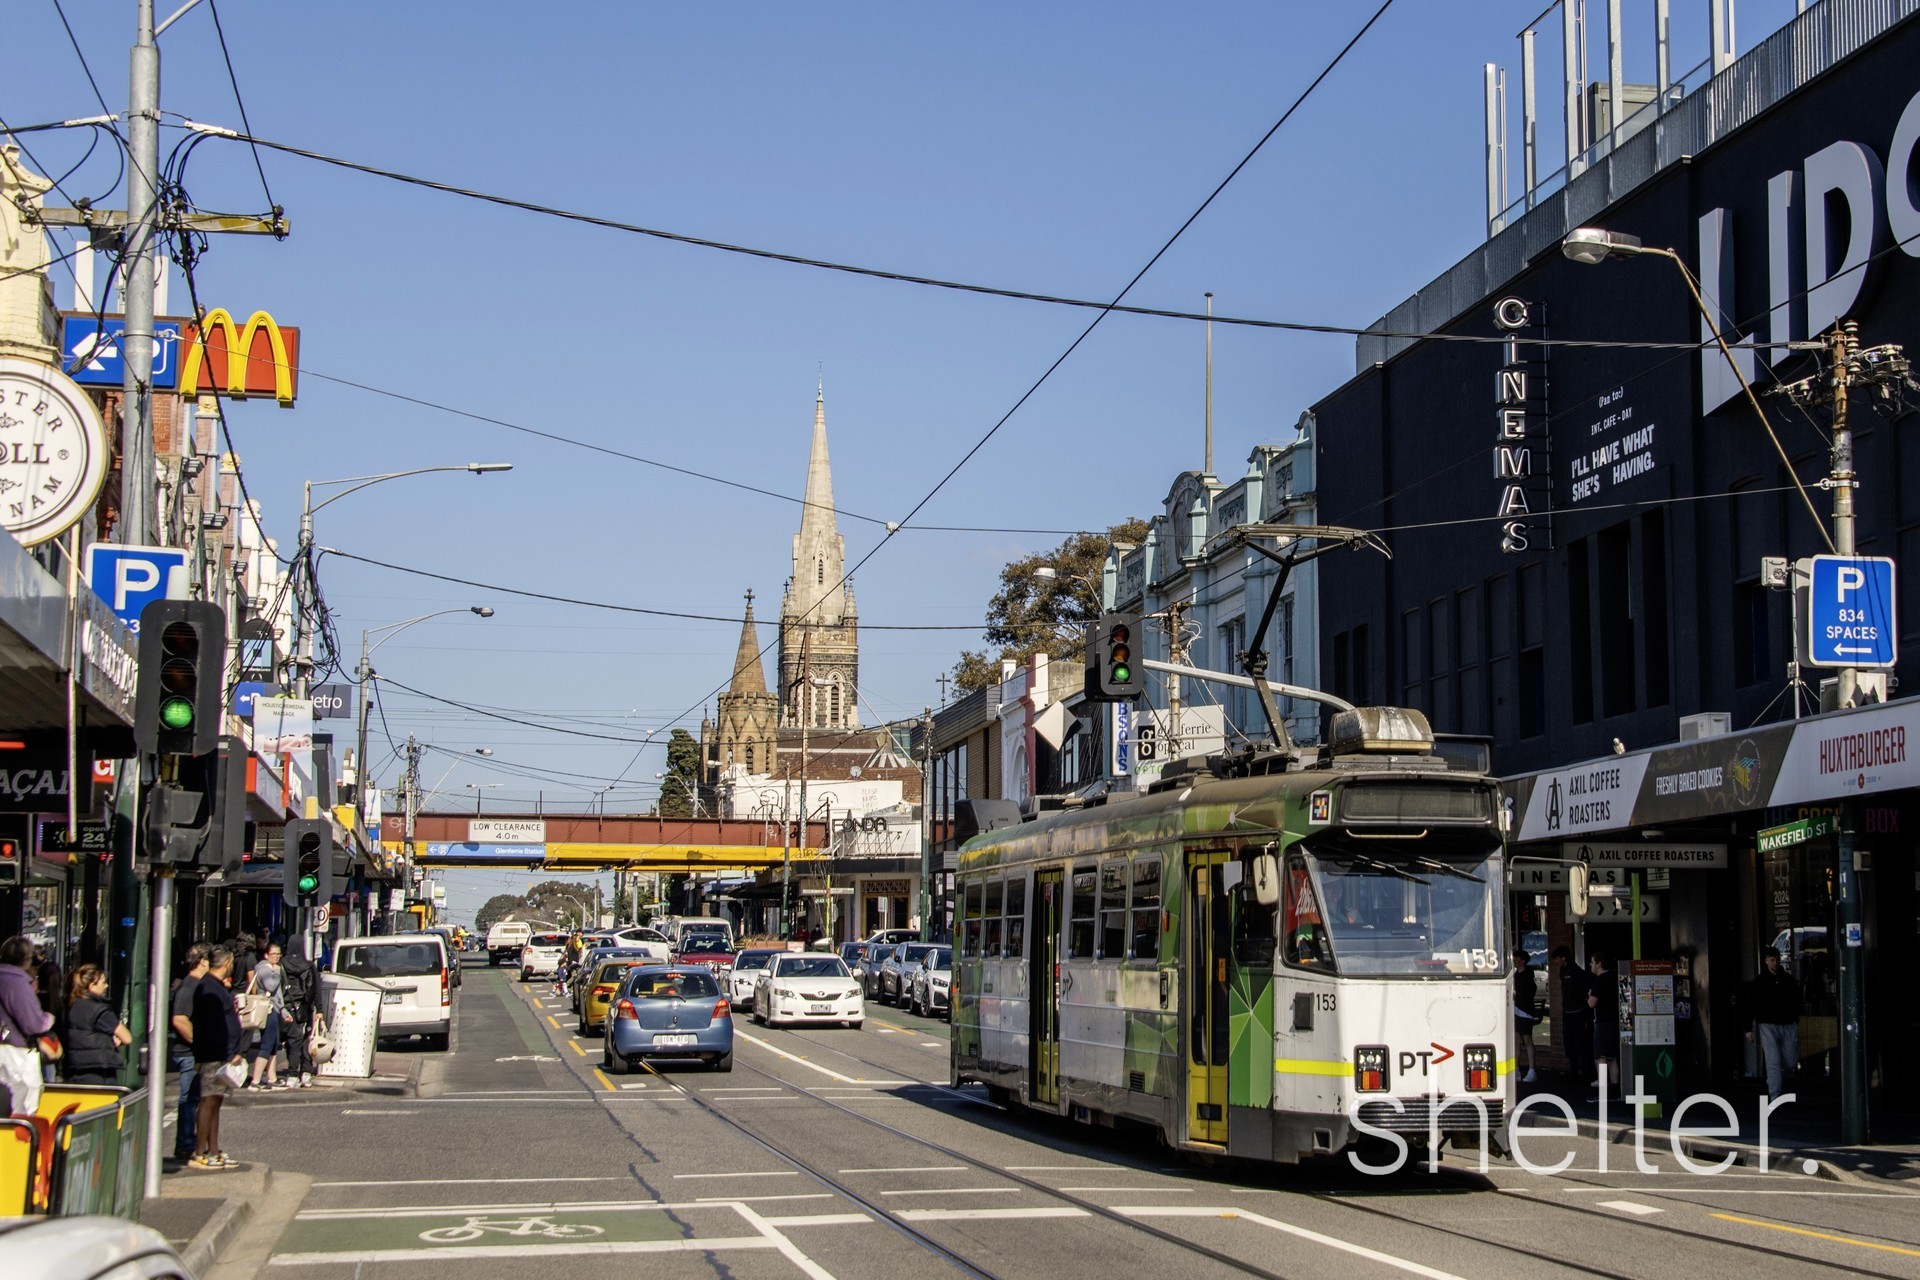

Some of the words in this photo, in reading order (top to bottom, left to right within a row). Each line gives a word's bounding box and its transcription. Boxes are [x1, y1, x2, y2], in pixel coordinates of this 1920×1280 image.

[1494, 296, 1531, 554] CINEMAS
[1591, 422, 1602, 436] INT.
[1604, 414, 1616, 430] CAFE
[1622, 407, 1632, 421] DAY
[1571, 456, 1590, 479] I'LL
[1592, 440, 1620, 470] HAVE
[1622, 424, 1655, 456] WHAT
[1572, 474, 1600, 502] SHE'S
[1612, 451, 1655, 485] HAVING.
[114, 558, 160, 610] P
[1837, 566, 1865, 603] P
[1838, 608, 1865, 622] 834
[1826, 625, 1878, 640] SPACES
[311, 695, 342, 709] etro
[1157, 724, 1211, 739] glferrie
[1157, 740, 1195, 755] opcal
[1819, 725, 1906, 775] HUXTABURGER
[1569, 774, 1587, 796] AXIL
[1589, 768, 1620, 792] COFFEE
[1656, 775, 1678, 796] FRESHLY
[1679, 772, 1697, 793] BAKED
[1698, 766, 1723, 790] COOKIES
[832, 817, 887, 832] FONDA
[1569, 800, 1611, 826] ROASTERS
[1865, 807, 1901, 833] BOX
[82, 833, 106, 842] 24
[474, 823, 490, 831] LOW
[494, 823, 541, 831] CLEARANCE
[1760, 827, 1813, 851] WAKEFIELD
[1816, 822, 1827, 836] ST
[1599, 850, 1621, 860] AXIL
[1624, 850, 1661, 860] COFFEE
[1664, 850, 1714, 861] ROASTERS
[1520, 870, 1616, 884] INEAS
[1460, 948, 1498, 970] 153
[1316, 994, 1336, 1012] 153
